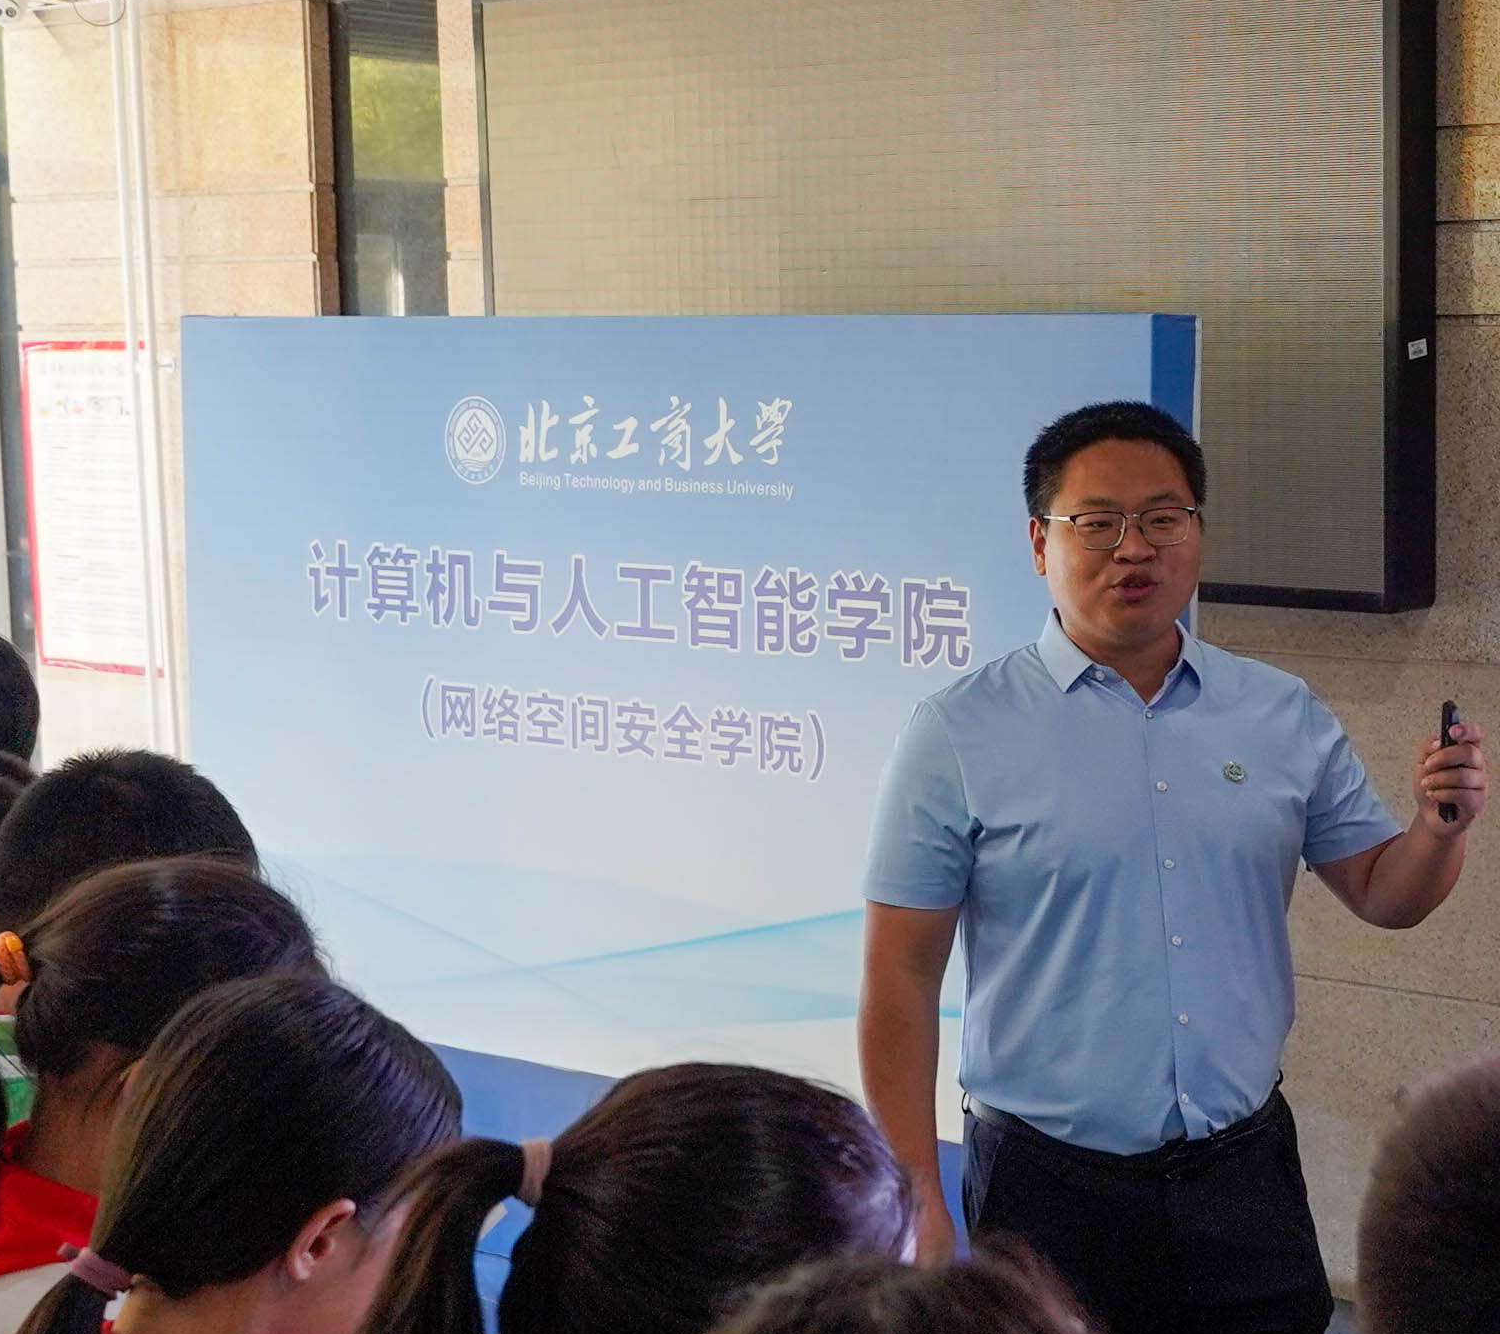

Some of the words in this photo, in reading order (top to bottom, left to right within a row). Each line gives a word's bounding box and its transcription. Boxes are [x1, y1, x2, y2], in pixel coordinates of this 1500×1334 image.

[519, 470, 561, 491] Beijing
[563, 472, 635, 494] Technology
[638, 476, 662, 493] and
[664, 477, 724, 495] Business
[727, 480, 794, 501] University
[307, 542, 971, 668] 计算机与人工智能学院
